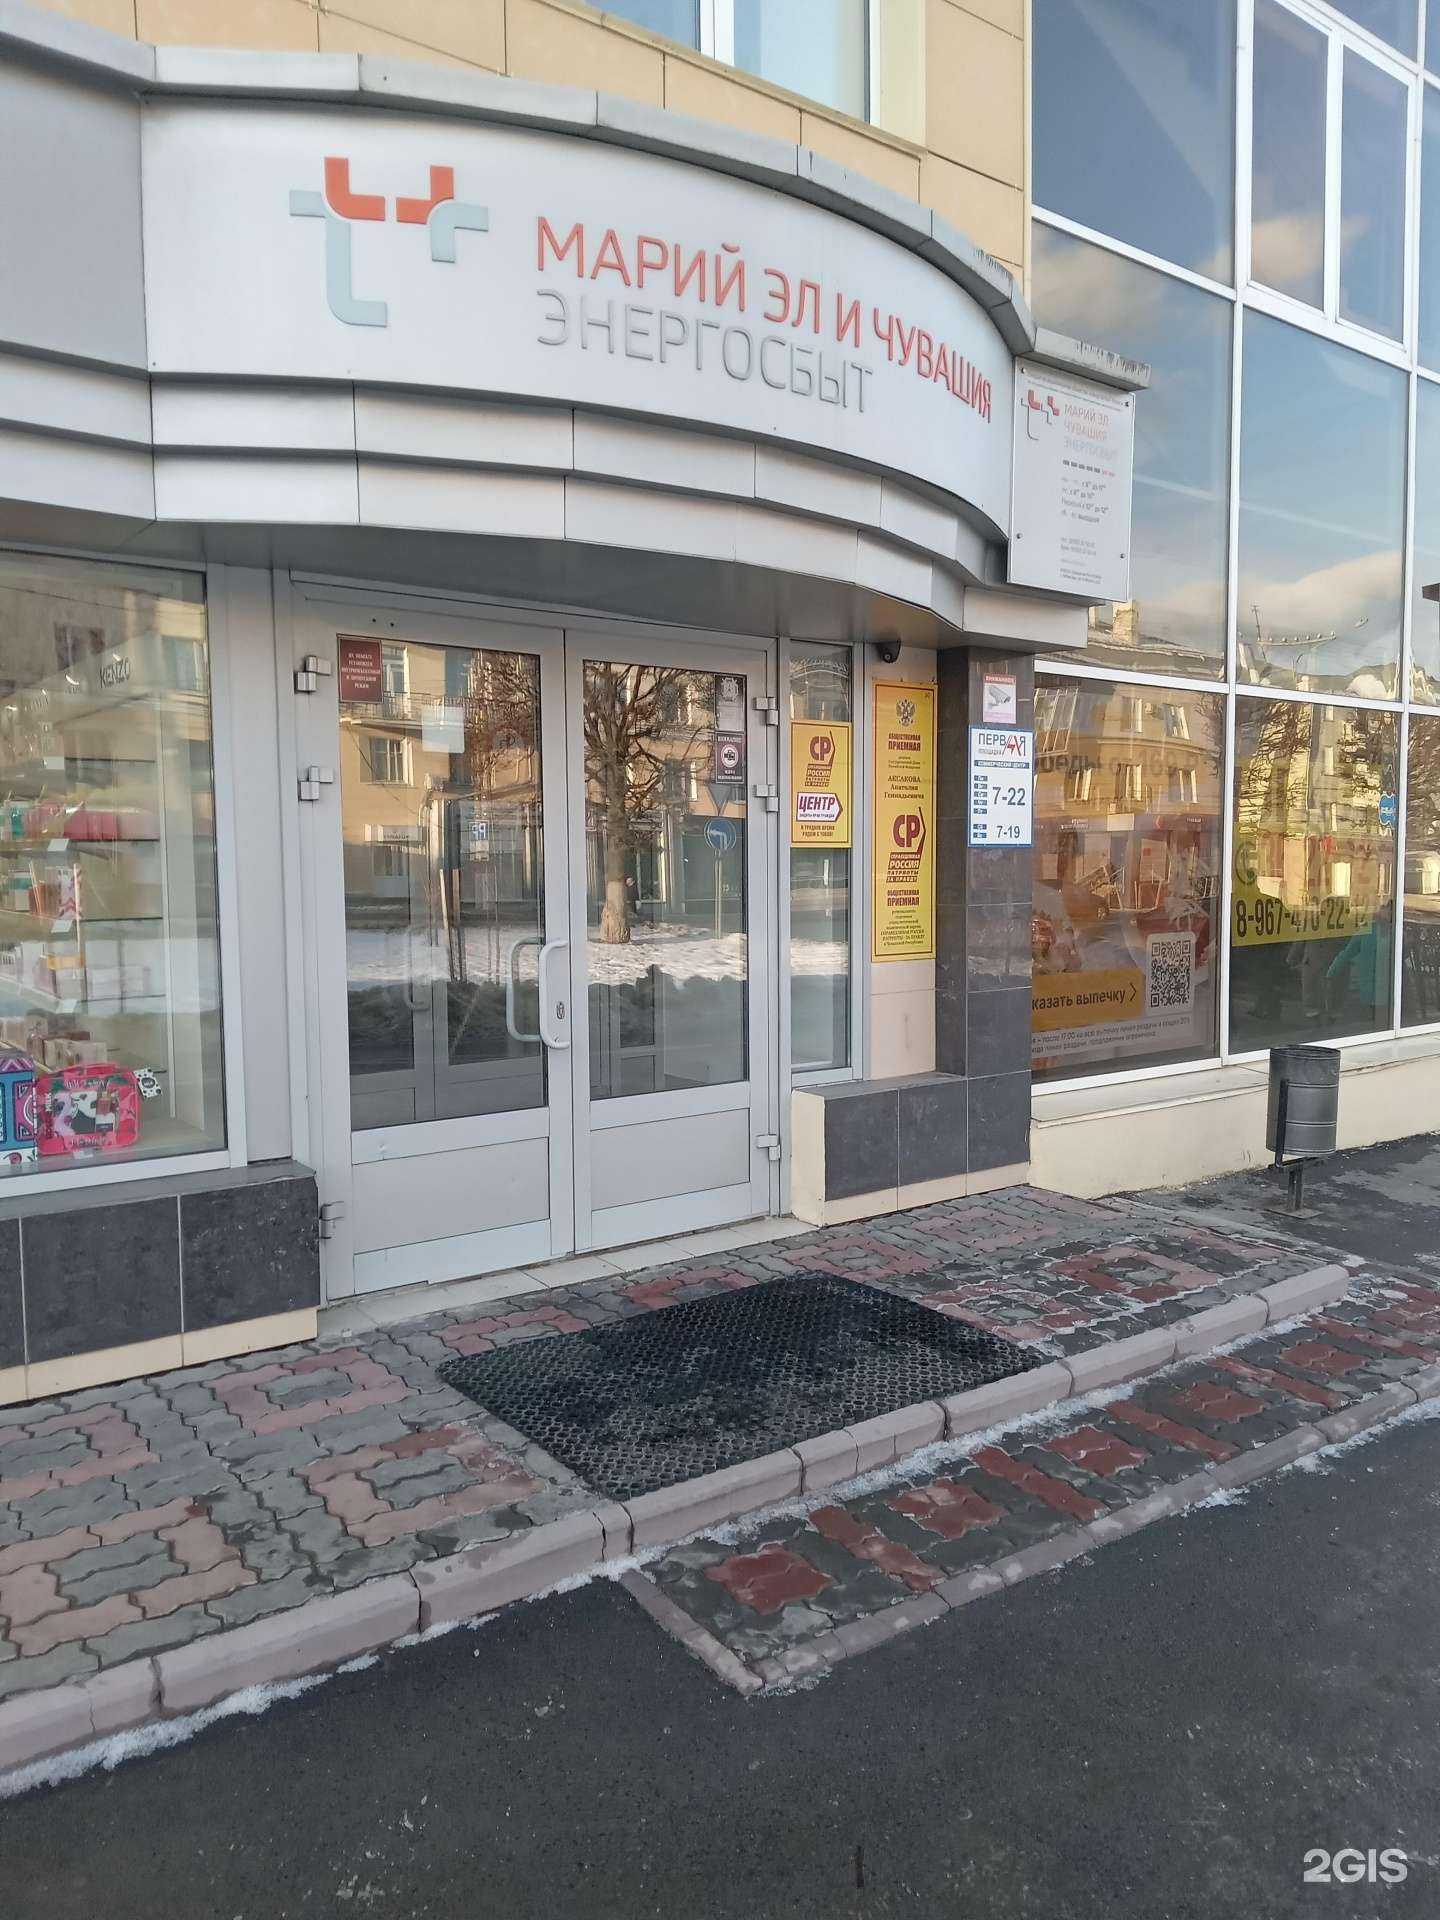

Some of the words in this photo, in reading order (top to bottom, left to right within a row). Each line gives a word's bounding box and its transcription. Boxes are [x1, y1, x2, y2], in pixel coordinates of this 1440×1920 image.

[537, 215, 746, 312] МАРИЙ
[763, 267, 822, 334] ЭЛ
[836, 291, 861, 349] И
[873, 306, 993, 424] ЧУВАШИЯ
[535, 288, 875, 414] ЭНЕРГОСБЫТ
[100, 657, 131, 689] KENZO
[809, 735, 832, 761] СР
[978, 733, 1026, 757] ПЕРВАЯ
[799, 795, 836, 812] ЦЕНТР
[992, 786, 1026, 806] 7-22
[892, 814, 921, 848] СР
[996, 825, 1021, 839] 7-19
[889, 860, 920, 869] РОССИЯ
[1076, 989, 1126, 1006] выпечку
